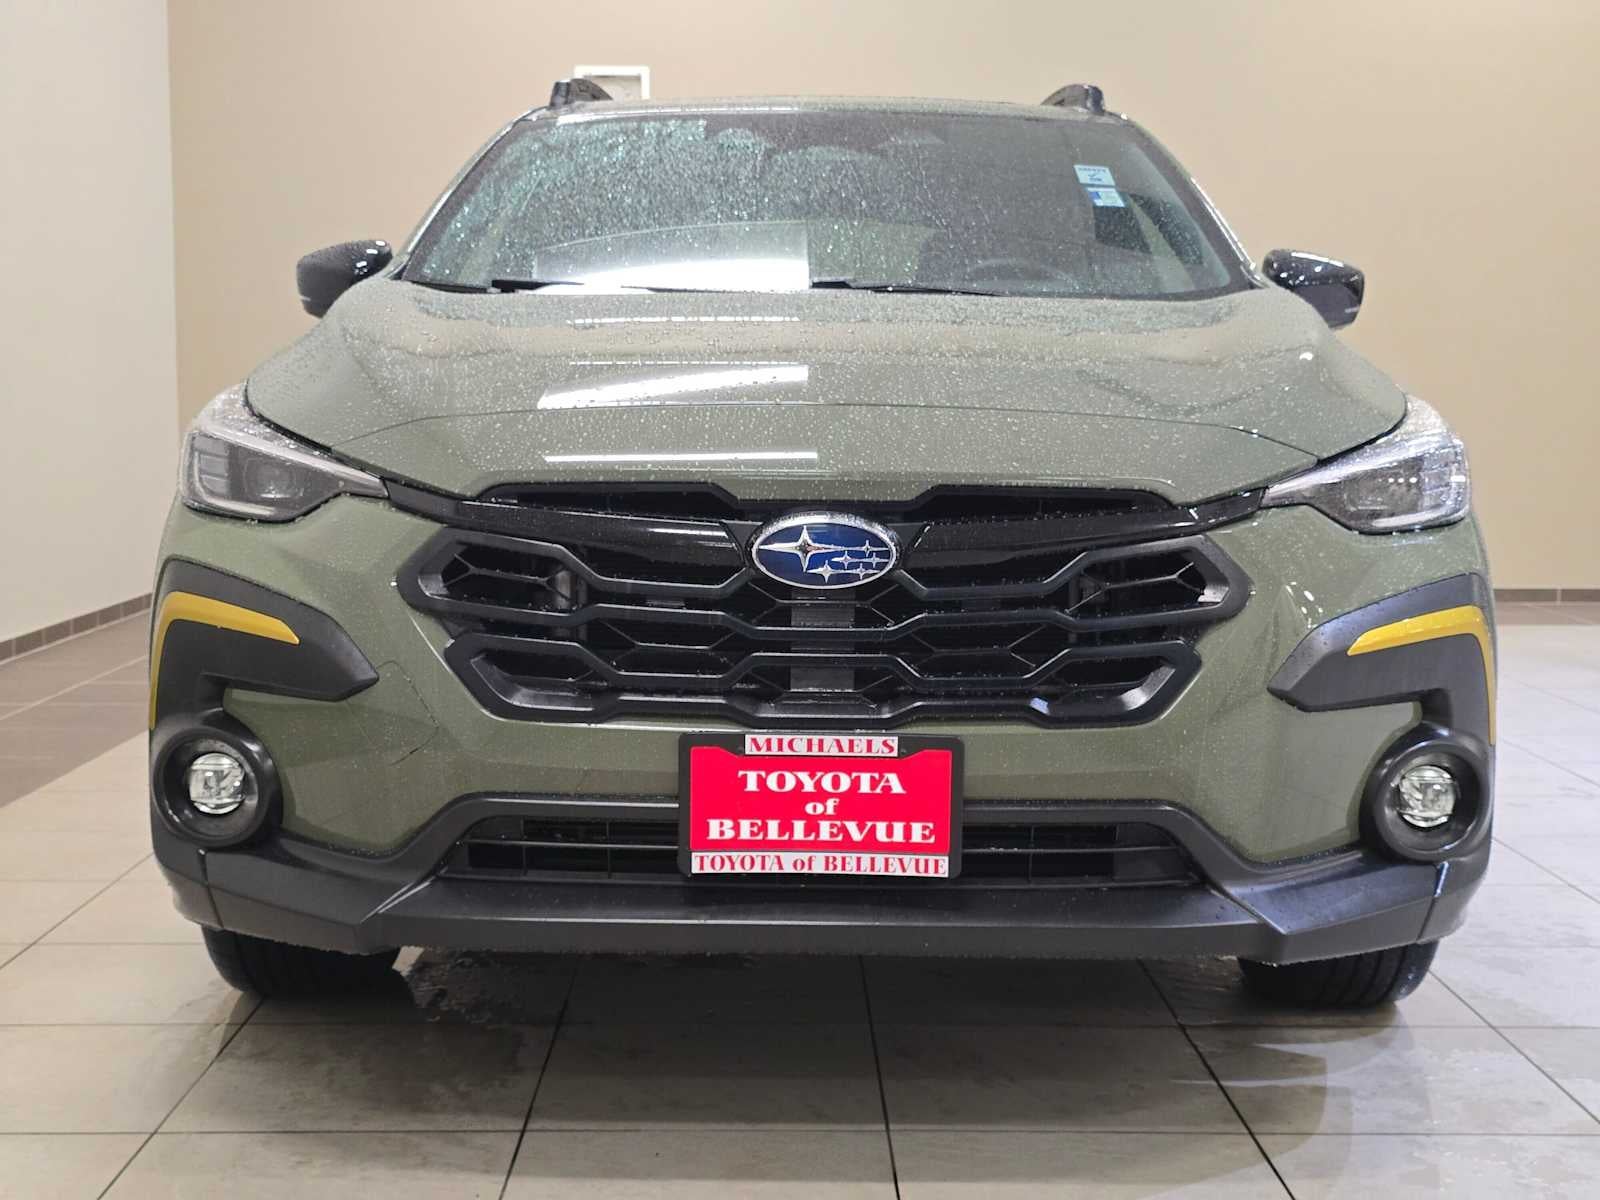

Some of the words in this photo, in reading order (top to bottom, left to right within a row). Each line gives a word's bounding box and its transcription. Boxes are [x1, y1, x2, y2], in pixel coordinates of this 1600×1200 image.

[749, 737, 895, 755] MICHAELS
[738, 770, 907, 794] TOYOTA
[804, 798, 840, 815] of
[706, 818, 936, 844] BELLEVUE
[695, 854, 785, 872] TOYOTA
[792, 854, 815, 872] of
[824, 855, 946, 876] BELLEVUE
